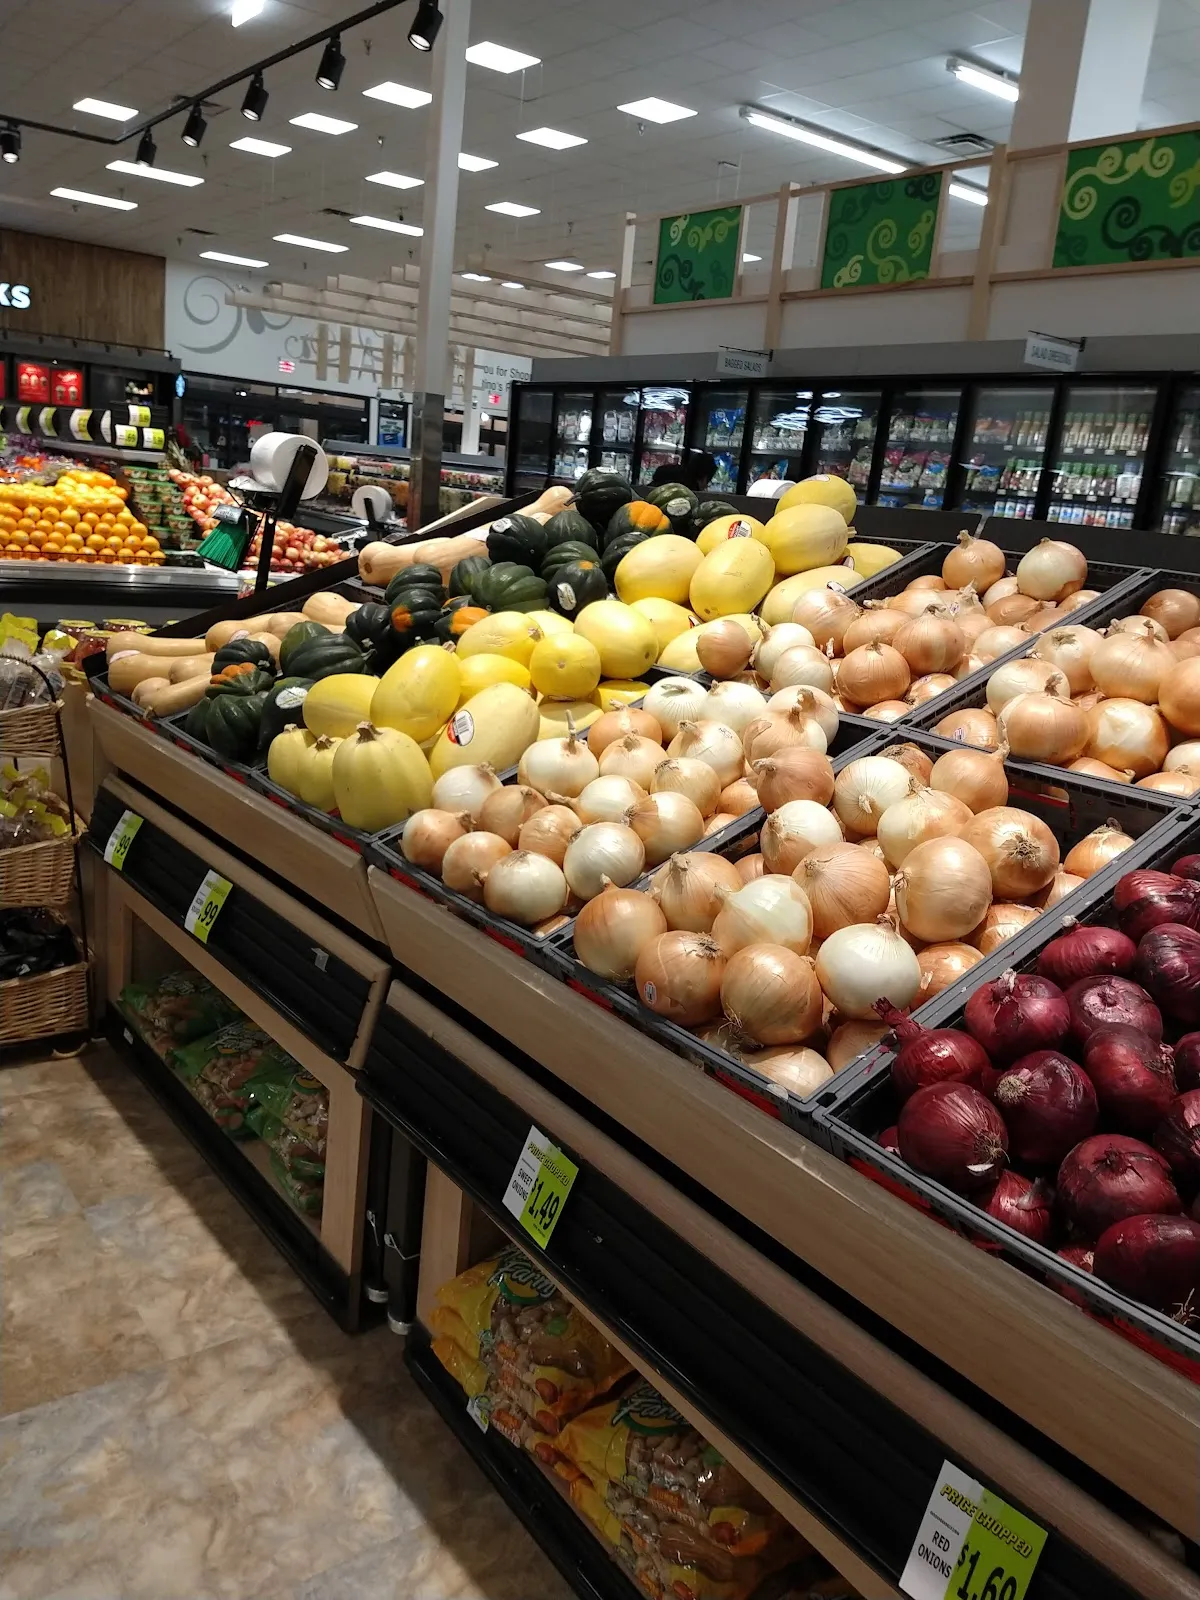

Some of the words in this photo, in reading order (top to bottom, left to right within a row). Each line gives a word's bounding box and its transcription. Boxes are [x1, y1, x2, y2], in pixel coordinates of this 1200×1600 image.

[496, 365, 508, 377] for
[724, 357, 743, 370] BAGGED
[743, 360, 762, 373] SALADS
[114, 834, 130, 856] .99
[198, 900, 219, 926] .99
[517, 1168, 533, 1186] SWEET
[511, 1179, 529, 1202] ONIONS
[528, 1176, 560, 1231] $1.49
[939, 1483, 977, 1519] PRICE
[975, 1509, 1034, 1559] CHOPPED
[931, 1530, 951, 1553] RED
[917, 1543, 953, 1579] ONIONS
